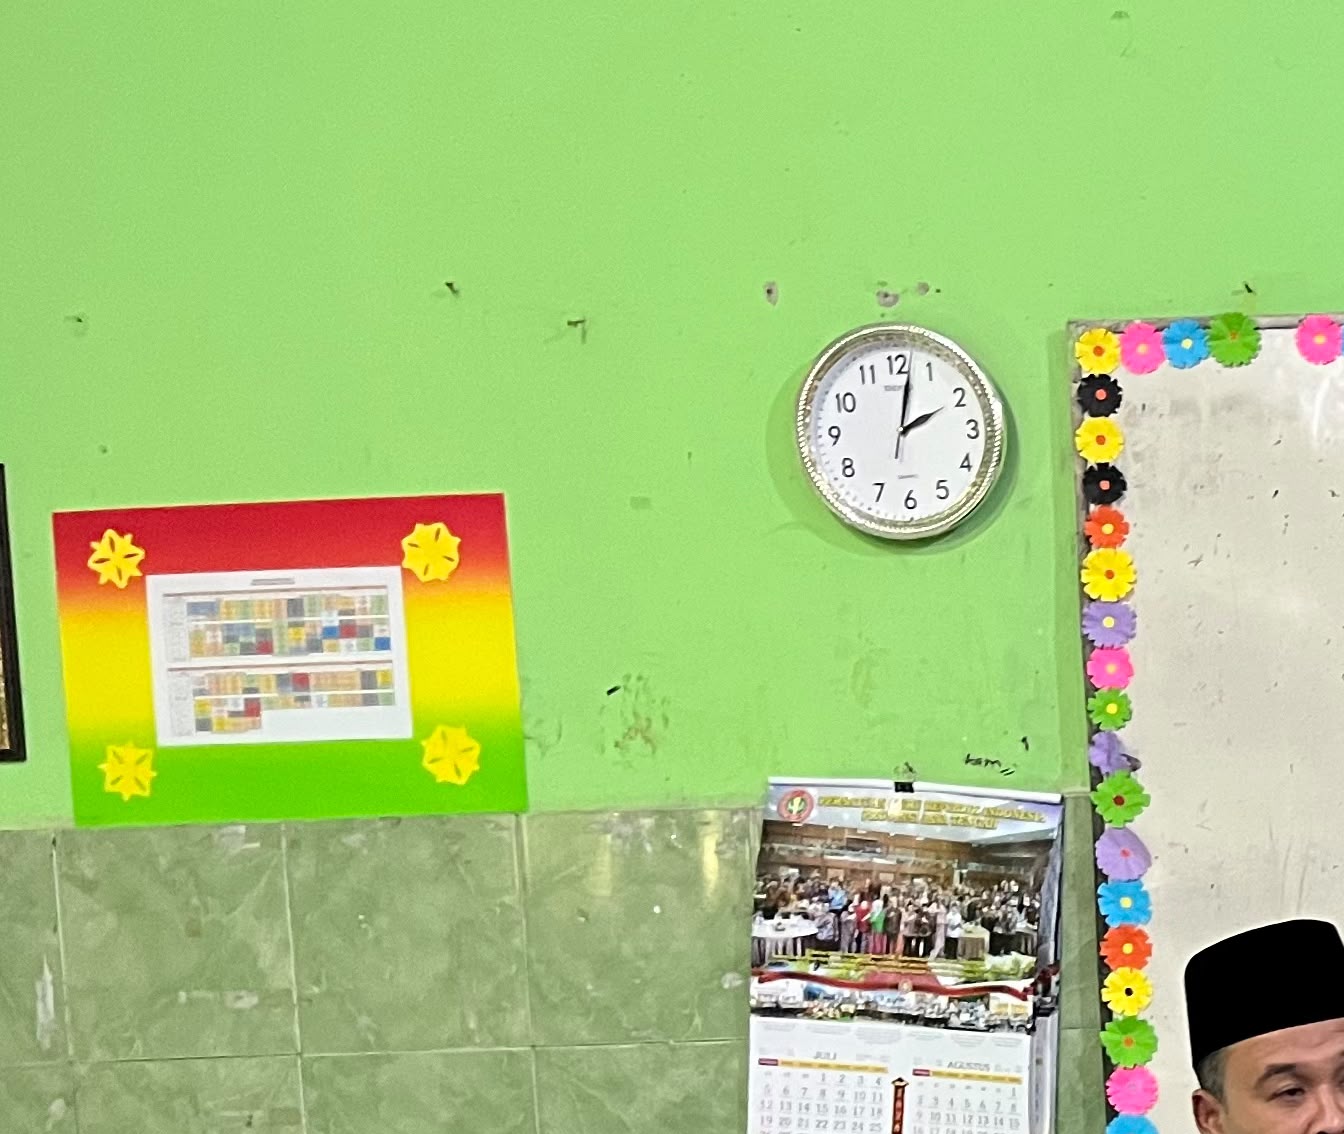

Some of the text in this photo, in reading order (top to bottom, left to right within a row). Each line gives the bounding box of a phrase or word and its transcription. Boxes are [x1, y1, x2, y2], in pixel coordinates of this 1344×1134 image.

[887, 354, 909, 375] 12
[926, 362, 933, 381] 1
[860, 365, 875, 384] 11
[836, 392, 856, 413] 10
[953, 388, 966, 408] 2
[828, 426, 841, 446] 9
[966, 419, 979, 439] 3
[842, 458, 854, 477] 8
[960, 453, 972, 472] 4
[873, 483, 885, 502] 7
[936, 480, 949, 499] 5
[904, 490, 917, 509] 6
